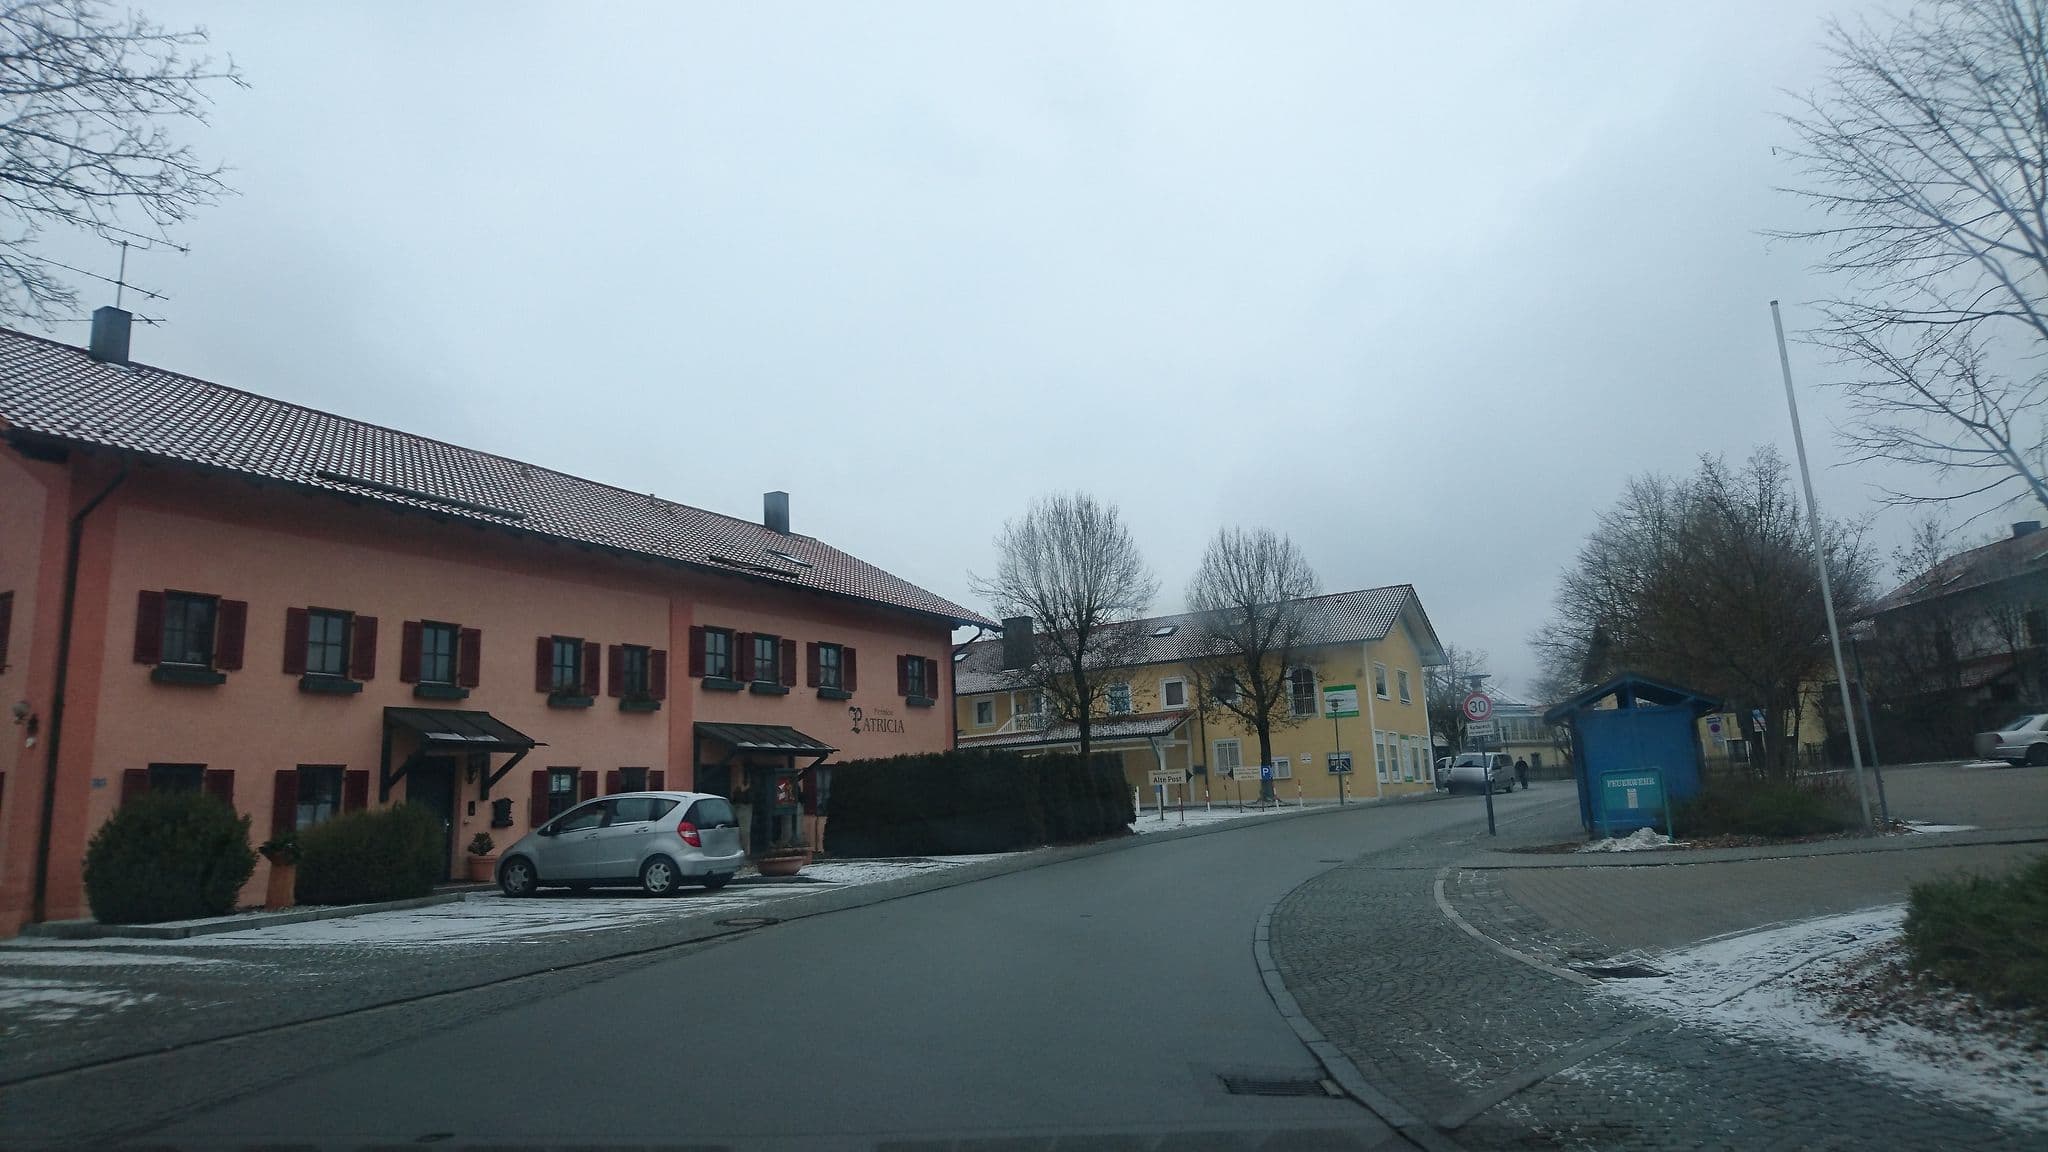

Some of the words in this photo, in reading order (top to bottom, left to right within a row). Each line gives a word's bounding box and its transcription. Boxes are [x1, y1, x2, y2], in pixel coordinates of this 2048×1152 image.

[1470, 701, 1485, 713] 30
[849, 706, 904, 733] PATRICIA
[1263, 767, 1270, 776] P
[1607, 777, 1655, 787] FEUERWEHR
